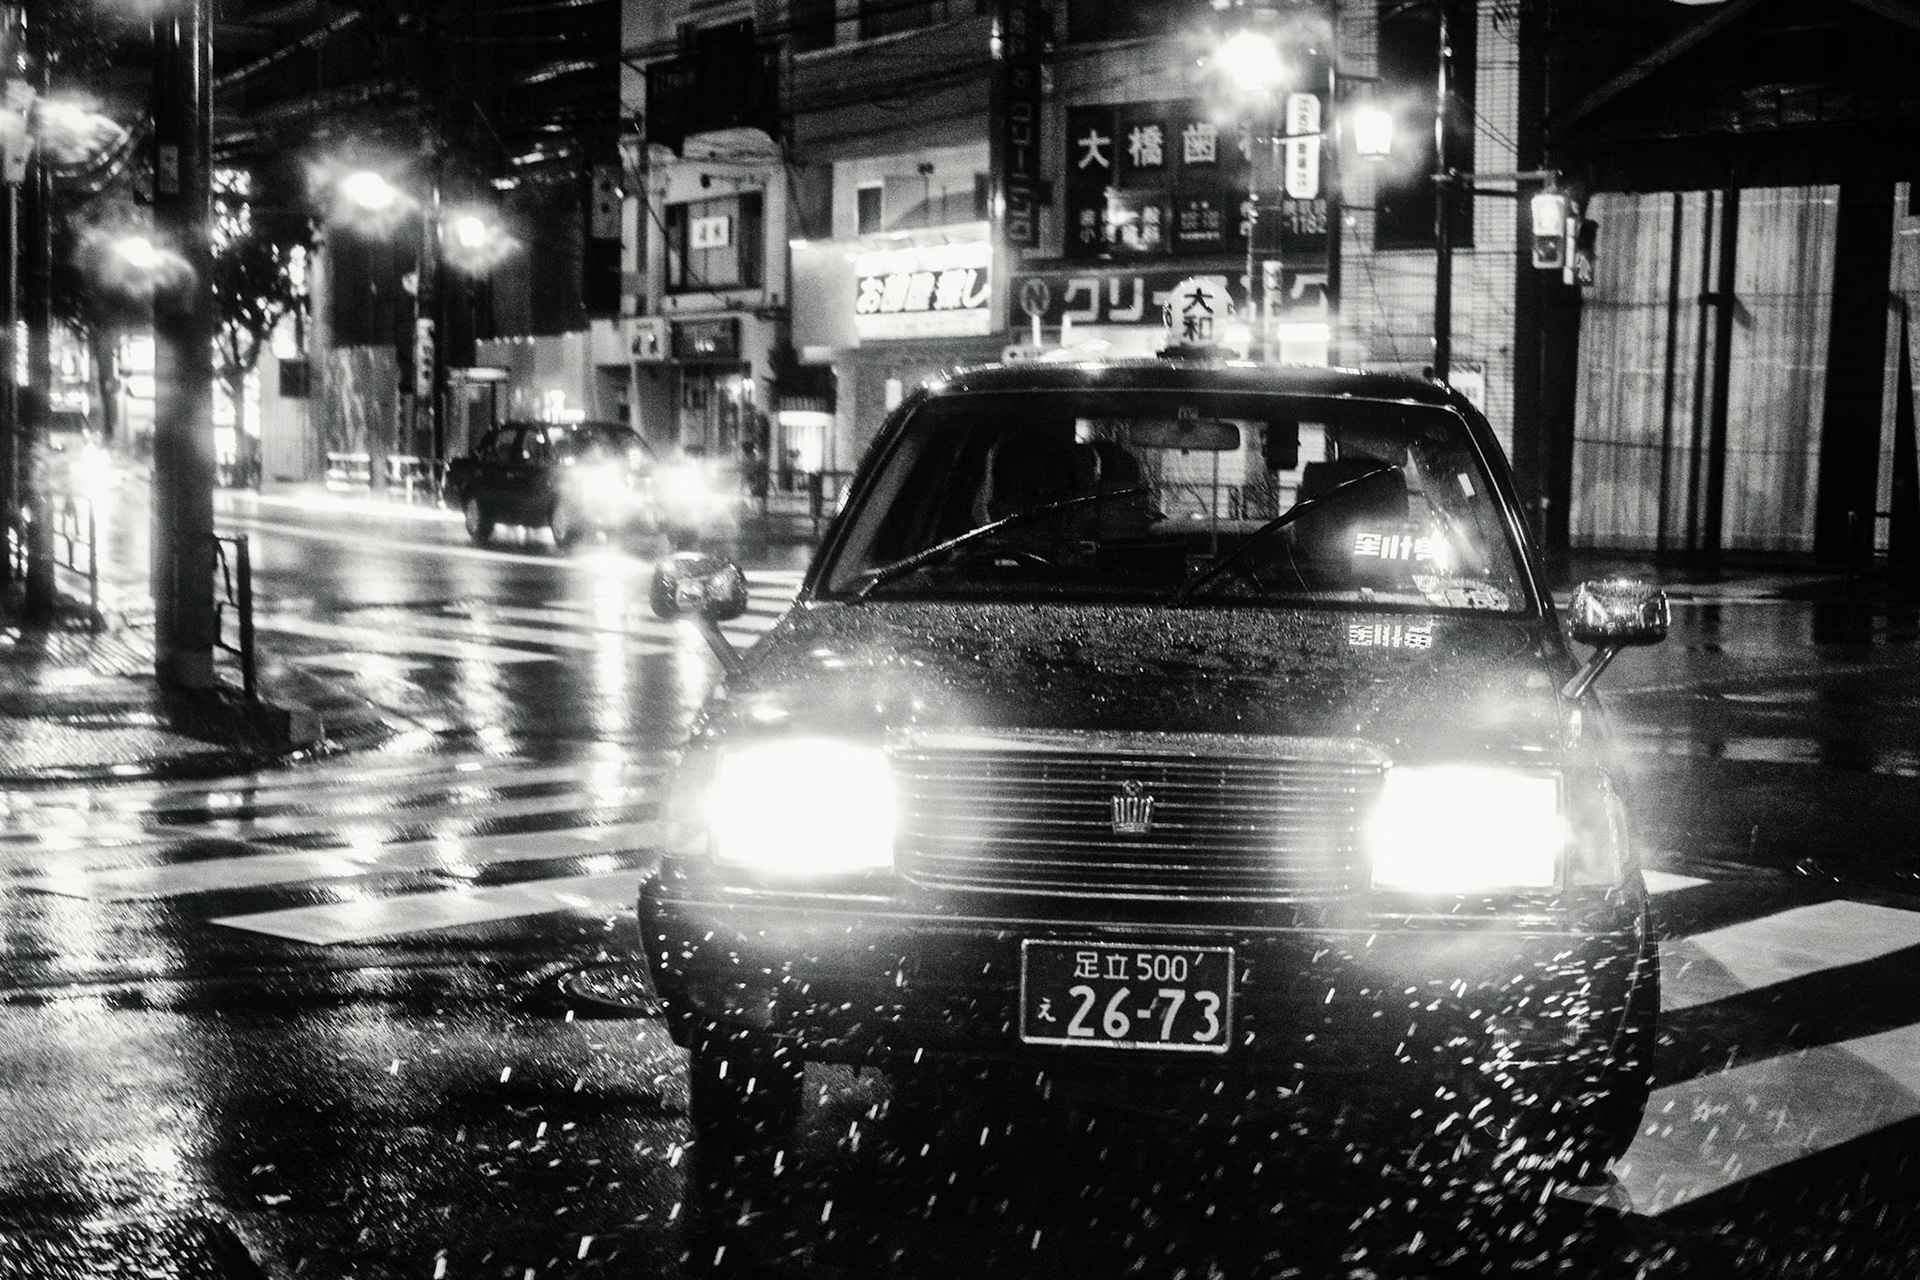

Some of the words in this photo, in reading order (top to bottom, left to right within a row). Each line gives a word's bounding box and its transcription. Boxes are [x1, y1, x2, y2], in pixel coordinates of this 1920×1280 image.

[1183, 287, 1214, 342] 大和
[1073, 951, 1130, 980] 足立
[1137, 954, 1188, 982] 500
[1037, 997, 1056, 1022] え
[1067, 986, 1221, 1042] 26-73
